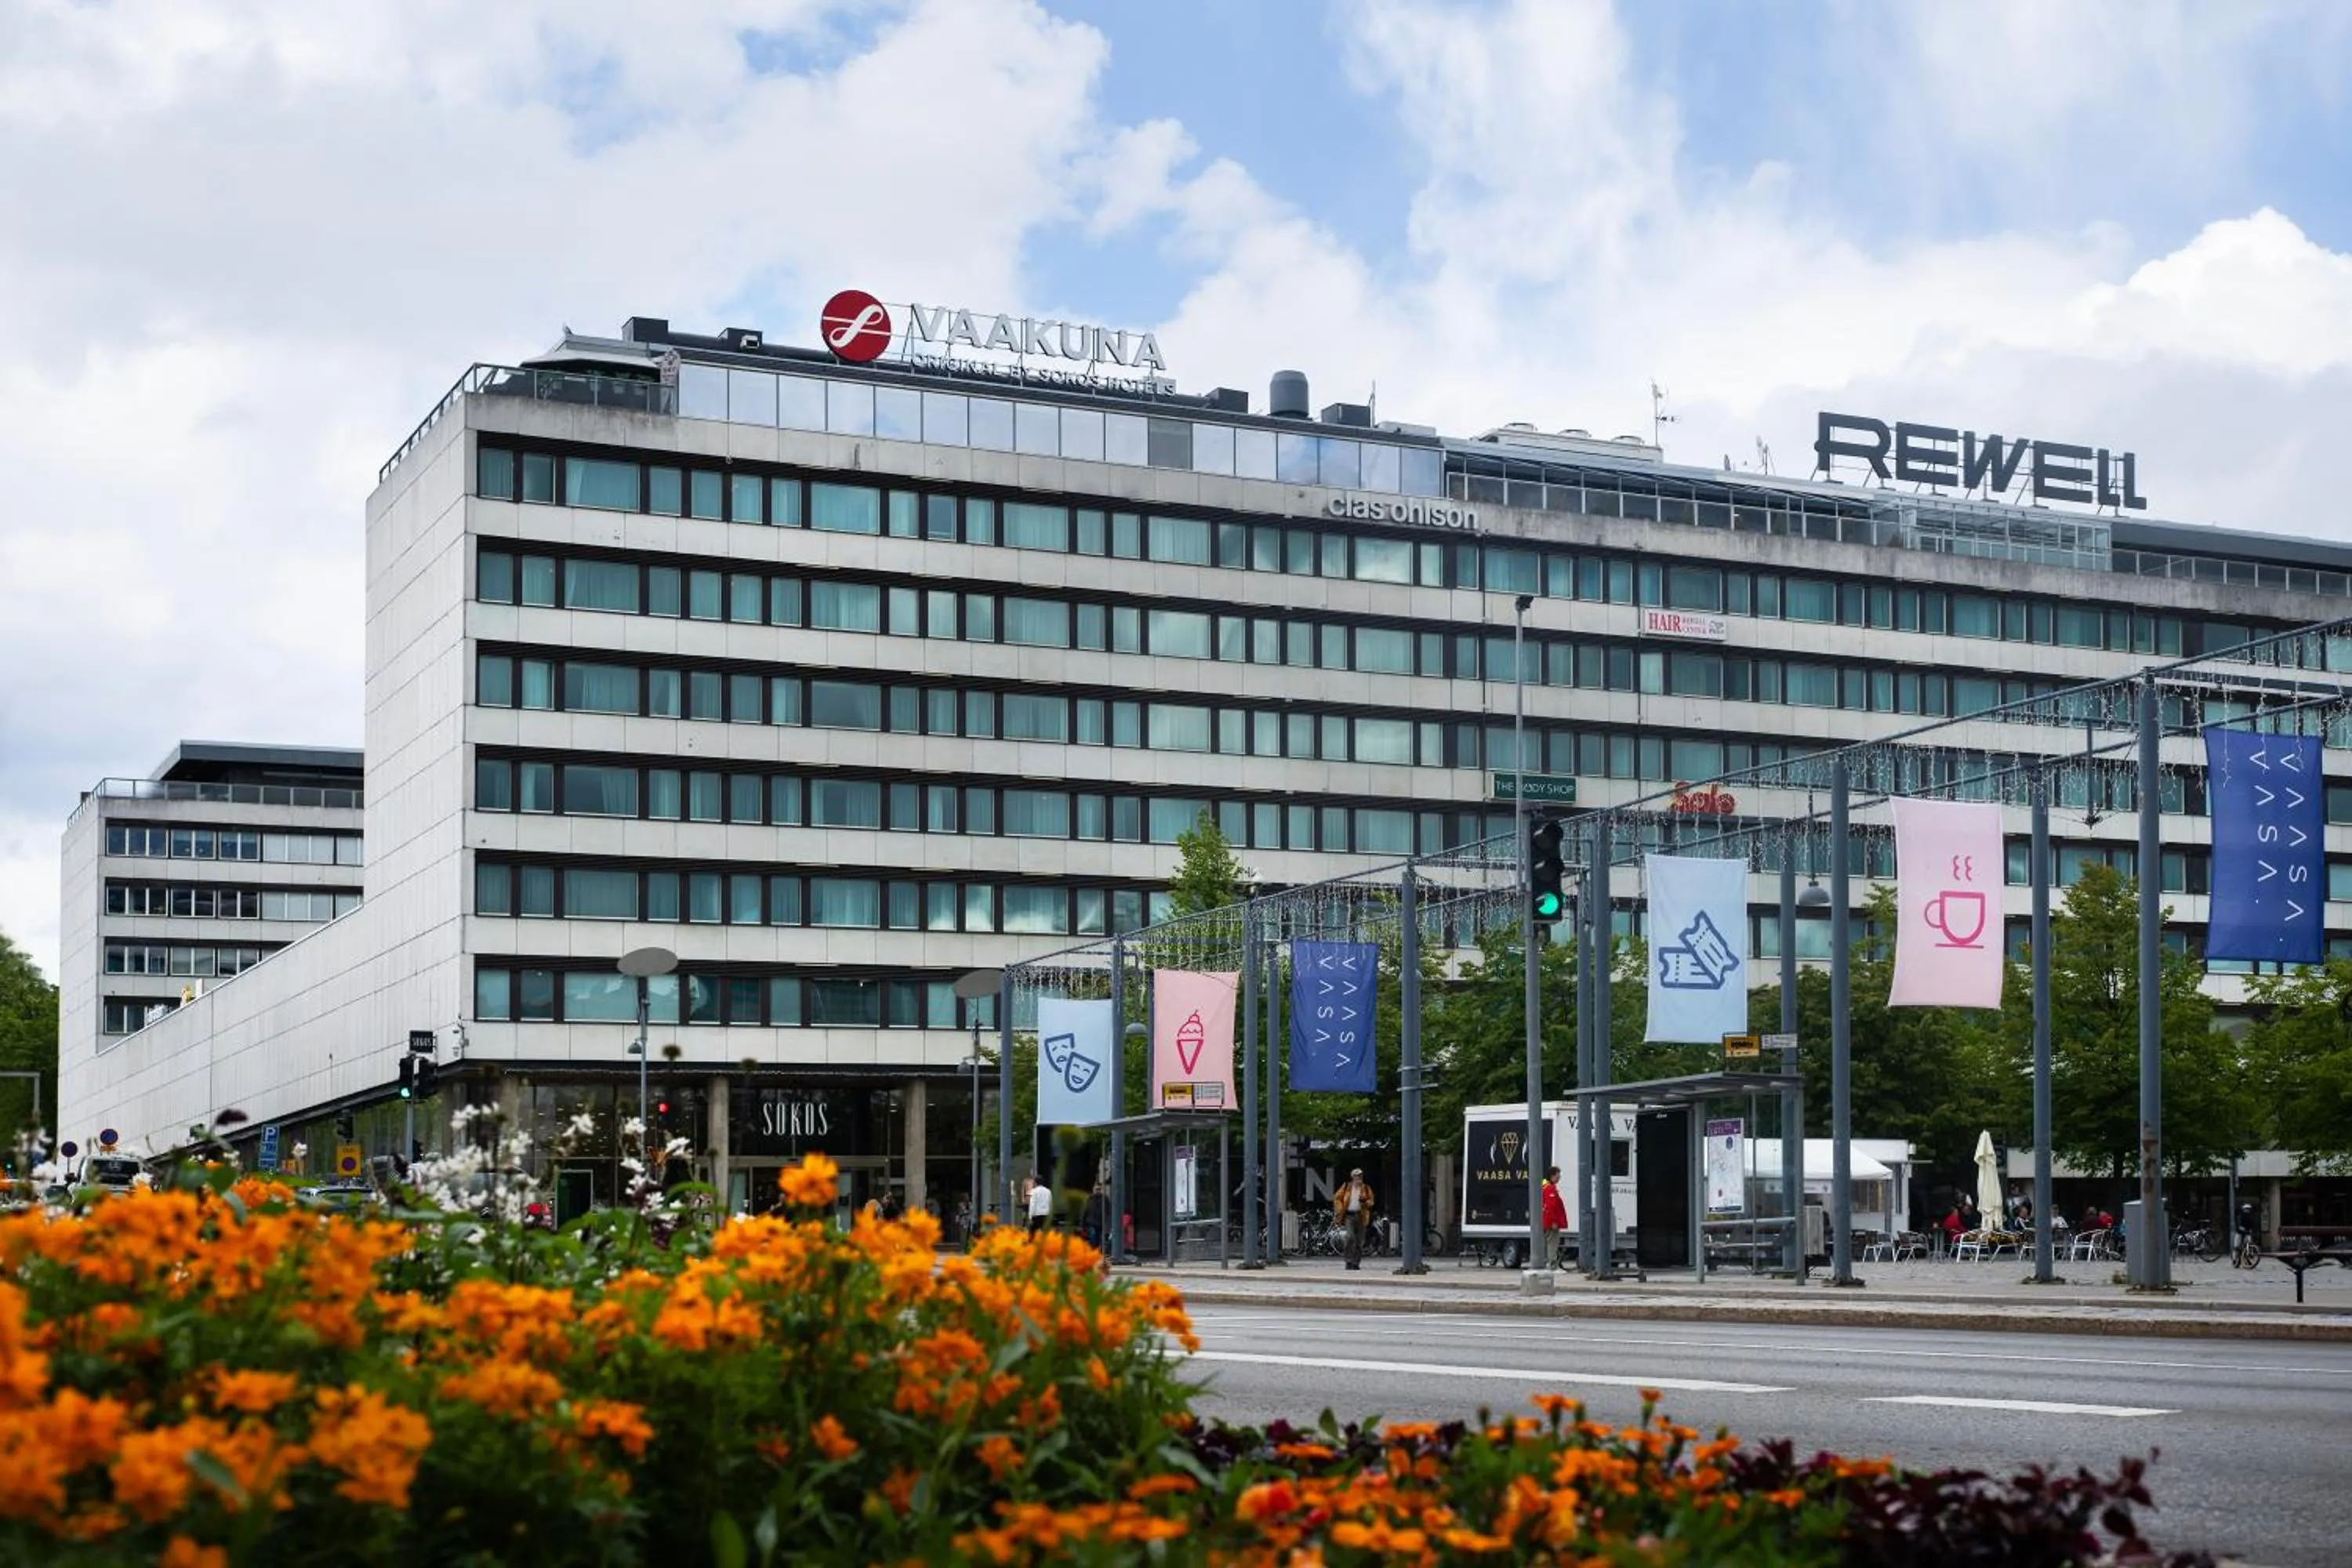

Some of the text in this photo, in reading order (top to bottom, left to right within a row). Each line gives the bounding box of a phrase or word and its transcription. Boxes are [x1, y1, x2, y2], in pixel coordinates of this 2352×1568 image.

[911, 303, 1166, 371] VAAKUNA
[1039, 368, 1101, 388] SOKOS
[1105, 376, 1176, 396] HOTELS
[1814, 412, 2147, 510] REWELL
[1329, 492, 1479, 529] clas ohlson
[1649, 612, 1682, 633] HAIR
[1495, 781, 1514, 792] THE
[763, 1102, 829, 1136] SOKOS
[264, 1127, 276, 1142] P
[1476, 1170, 1530, 1180] VAASA VA
